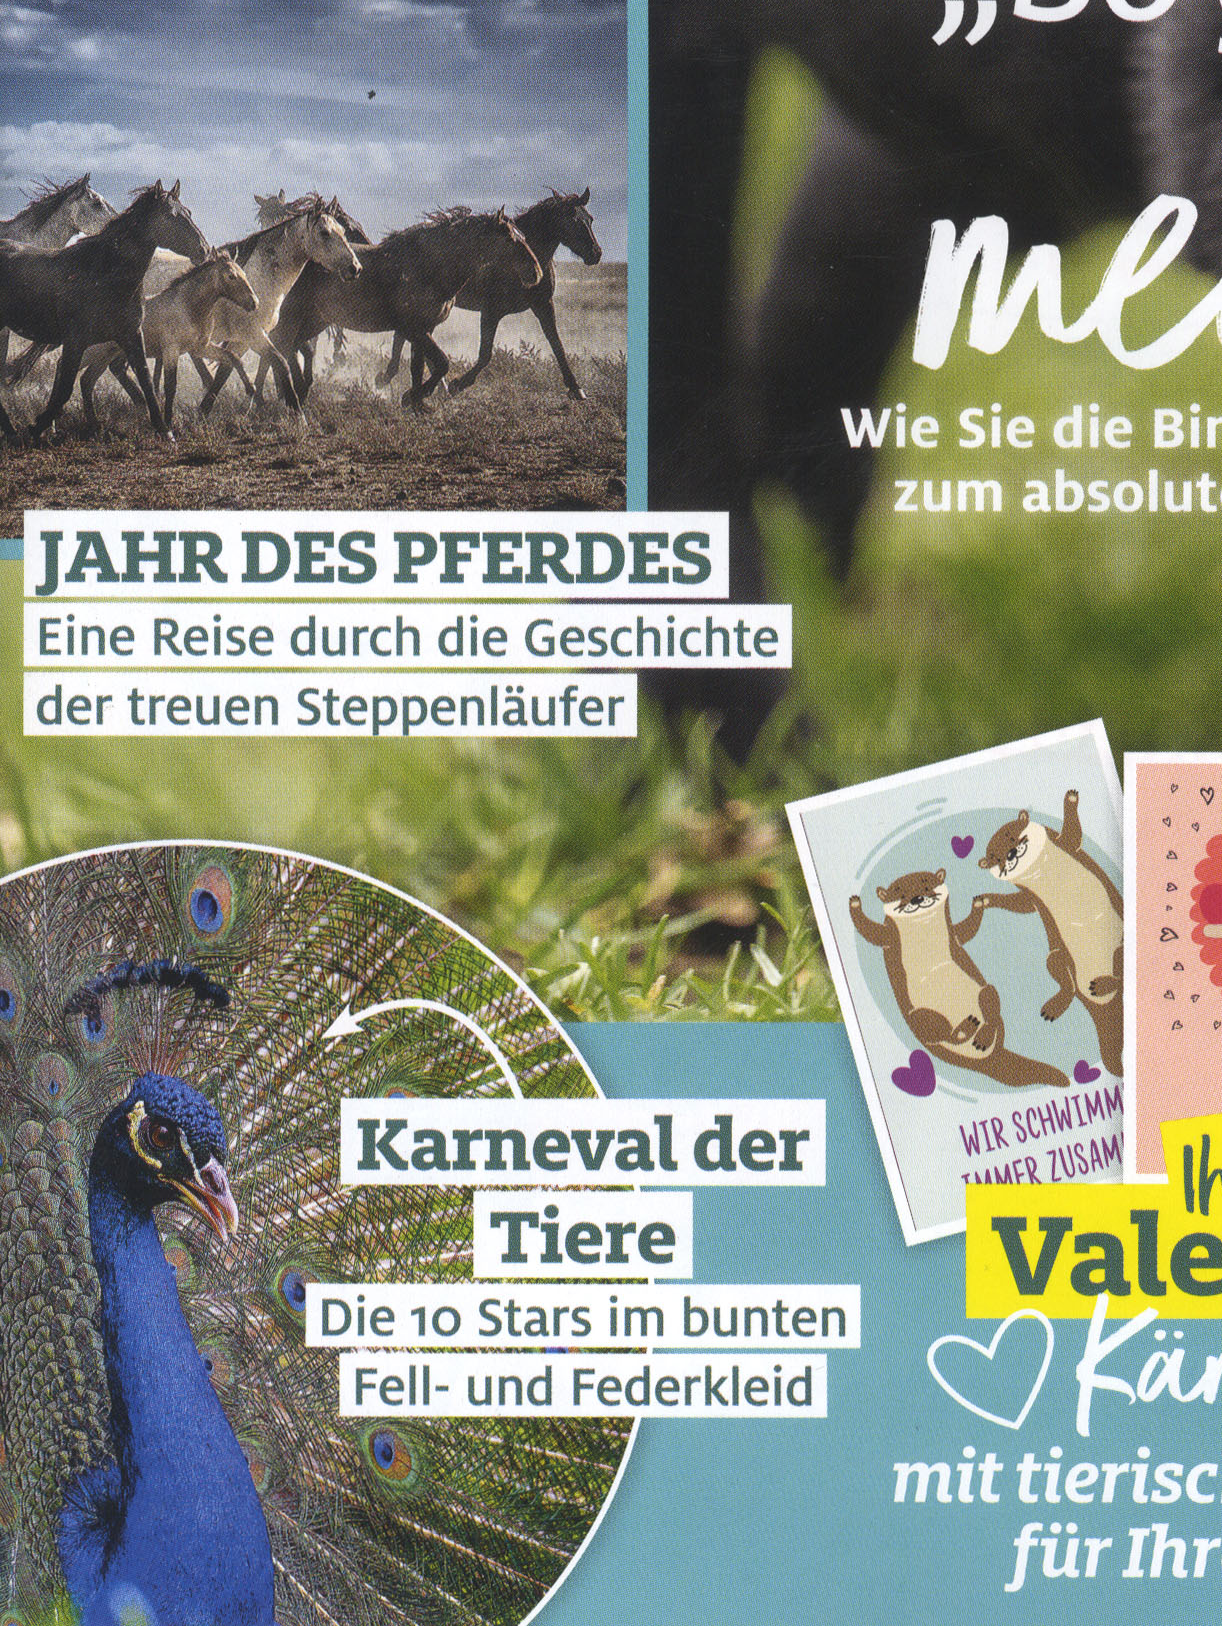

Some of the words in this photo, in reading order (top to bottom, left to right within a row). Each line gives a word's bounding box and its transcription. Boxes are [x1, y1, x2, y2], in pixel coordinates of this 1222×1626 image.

[840, 404, 940, 450] Wie
[956, 404, 1036, 450] Sie
[1052, 407, 1134, 452] die
[892, 482, 1002, 516] zum
[36, 532, 227, 597] JAHR
[242, 531, 377, 584] DES
[394, 532, 711, 584] PFERDES
[40, 614, 134, 656] Eine
[154, 615, 274, 656] Reise
[290, 616, 420, 656] durch
[438, 615, 507, 657] die
[525, 616, 778, 657] Geschichte
[37, 685, 112, 725] der
[128, 688, 278, 726] treuen
[296, 686, 624, 734] Steppenläufer
[358, 1115, 677, 1171] Karneval
[694, 1115, 809, 1171] der
[959, 1117, 1009, 1157] WIR
[1046, 1131, 1124, 1182] ZUSAM
[490, 1205, 675, 1264] Tiere
[322, 1295, 395, 1336] Die
[411, 1307, 461, 1337] 10
[479, 1299, 591, 1337] Stars
[610, 1296, 663, 1336] im
[684, 1297, 845, 1337] bunten
[356, 1365, 448, 1406] Fell-
[468, 1366, 552, 1406] und
[573, 1365, 812, 1407] Federkleid
[893, 1446, 1003, 1503] mit
[1004, 1522, 1112, 1592] für
